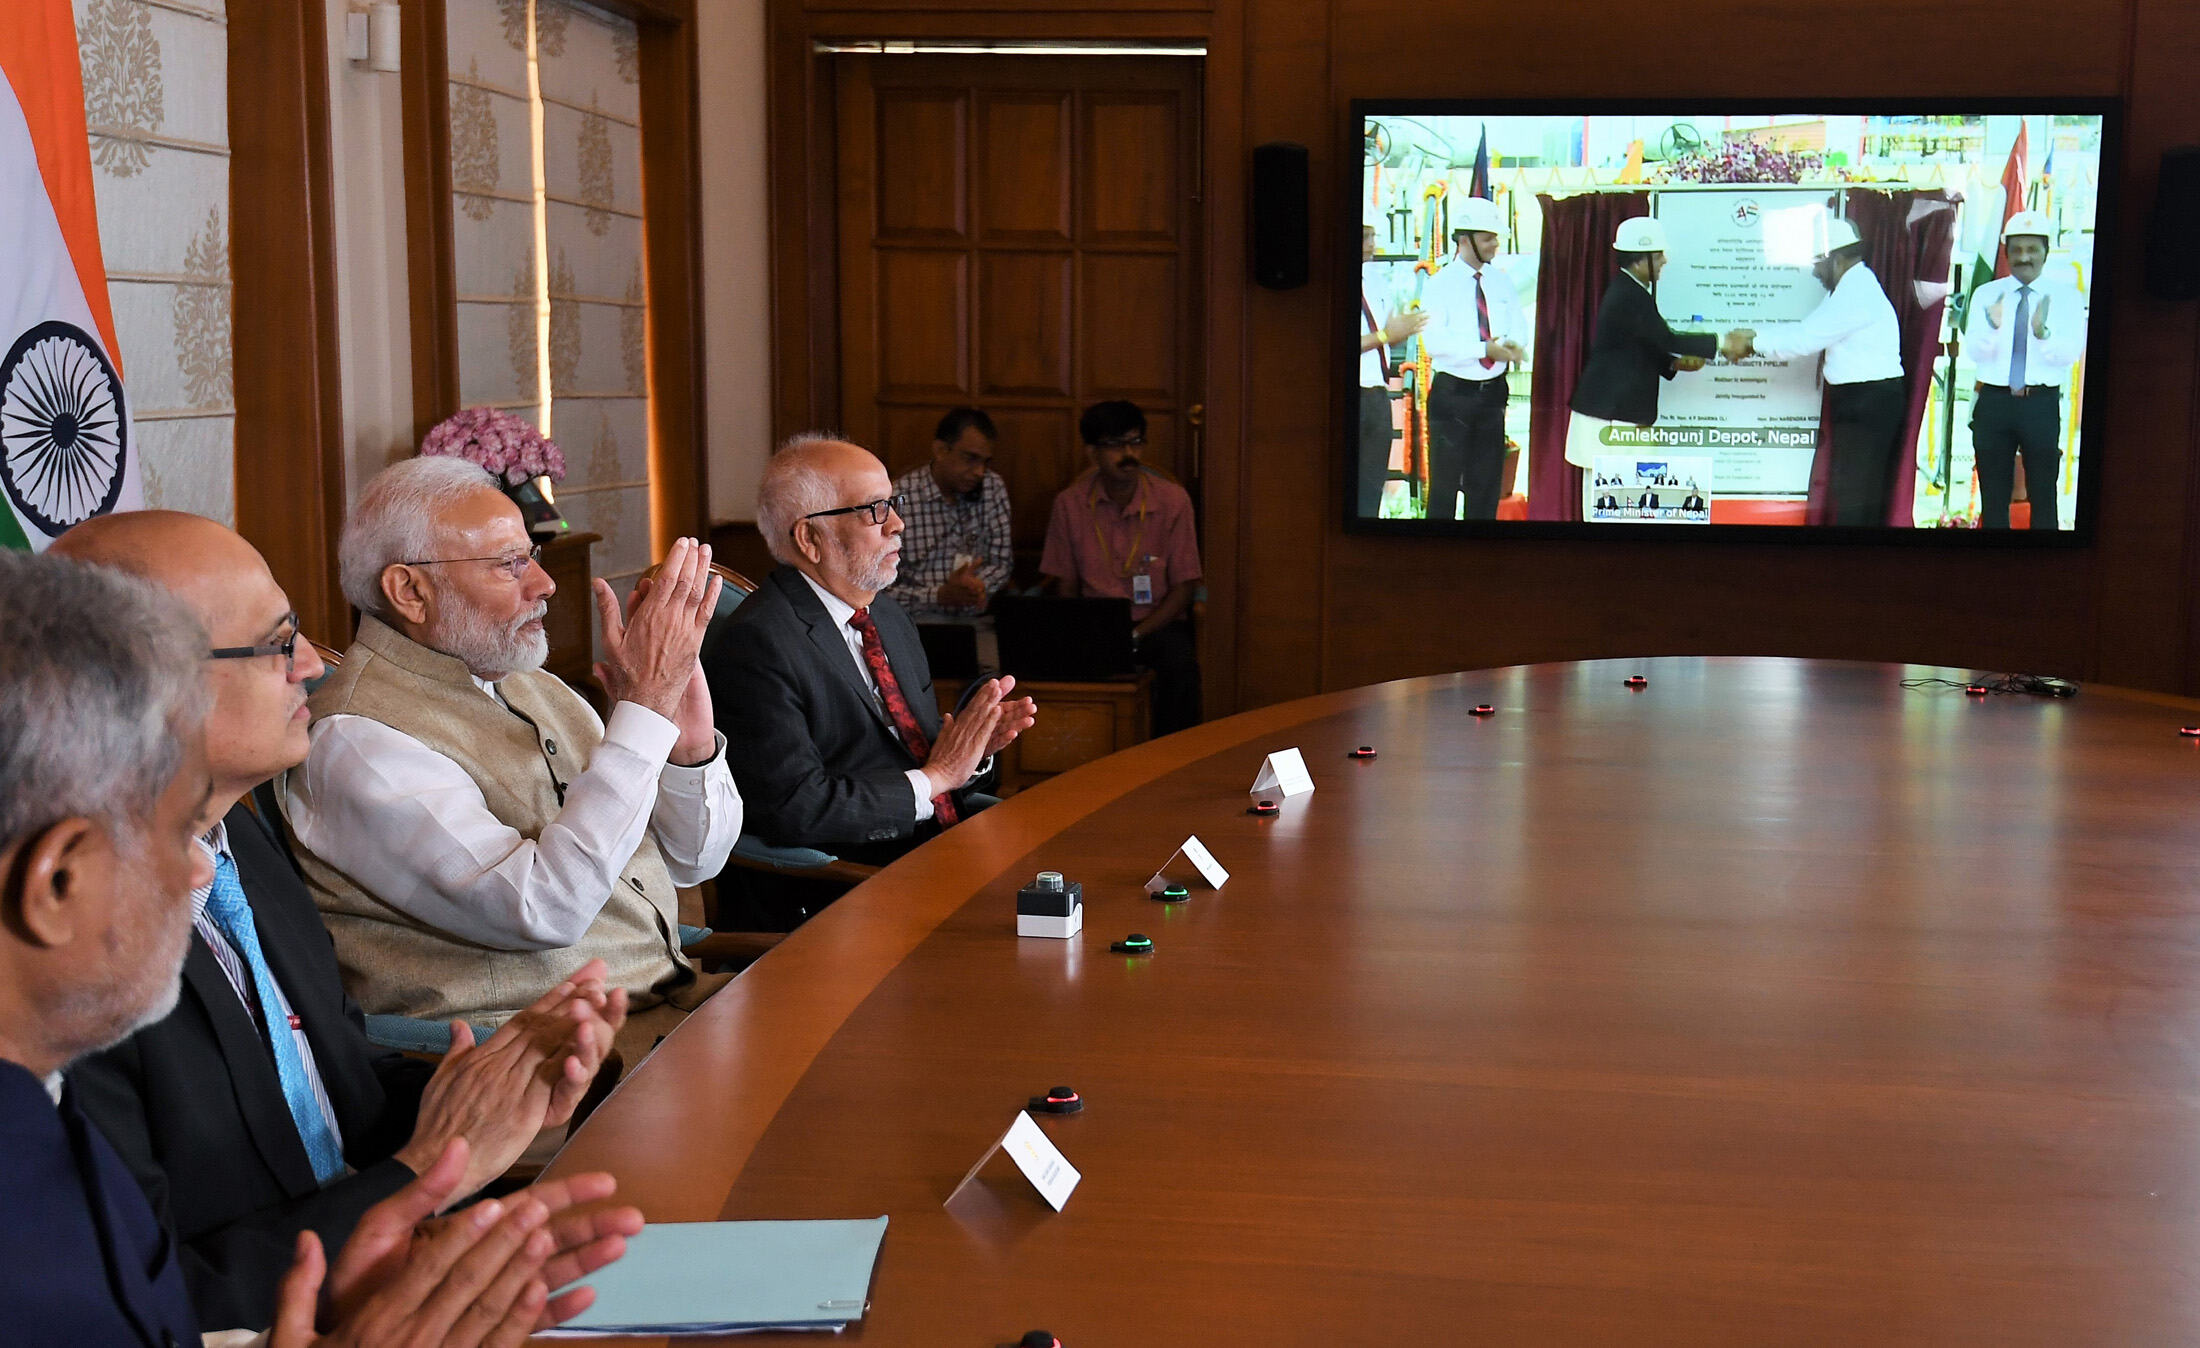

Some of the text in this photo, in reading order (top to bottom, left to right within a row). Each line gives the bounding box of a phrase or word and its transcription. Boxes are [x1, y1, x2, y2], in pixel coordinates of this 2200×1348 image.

[1608, 427, 1815, 447] Amlekhgunj Depot, Nepal
[1592, 507, 1709, 519] Prime Minister of Nepal
